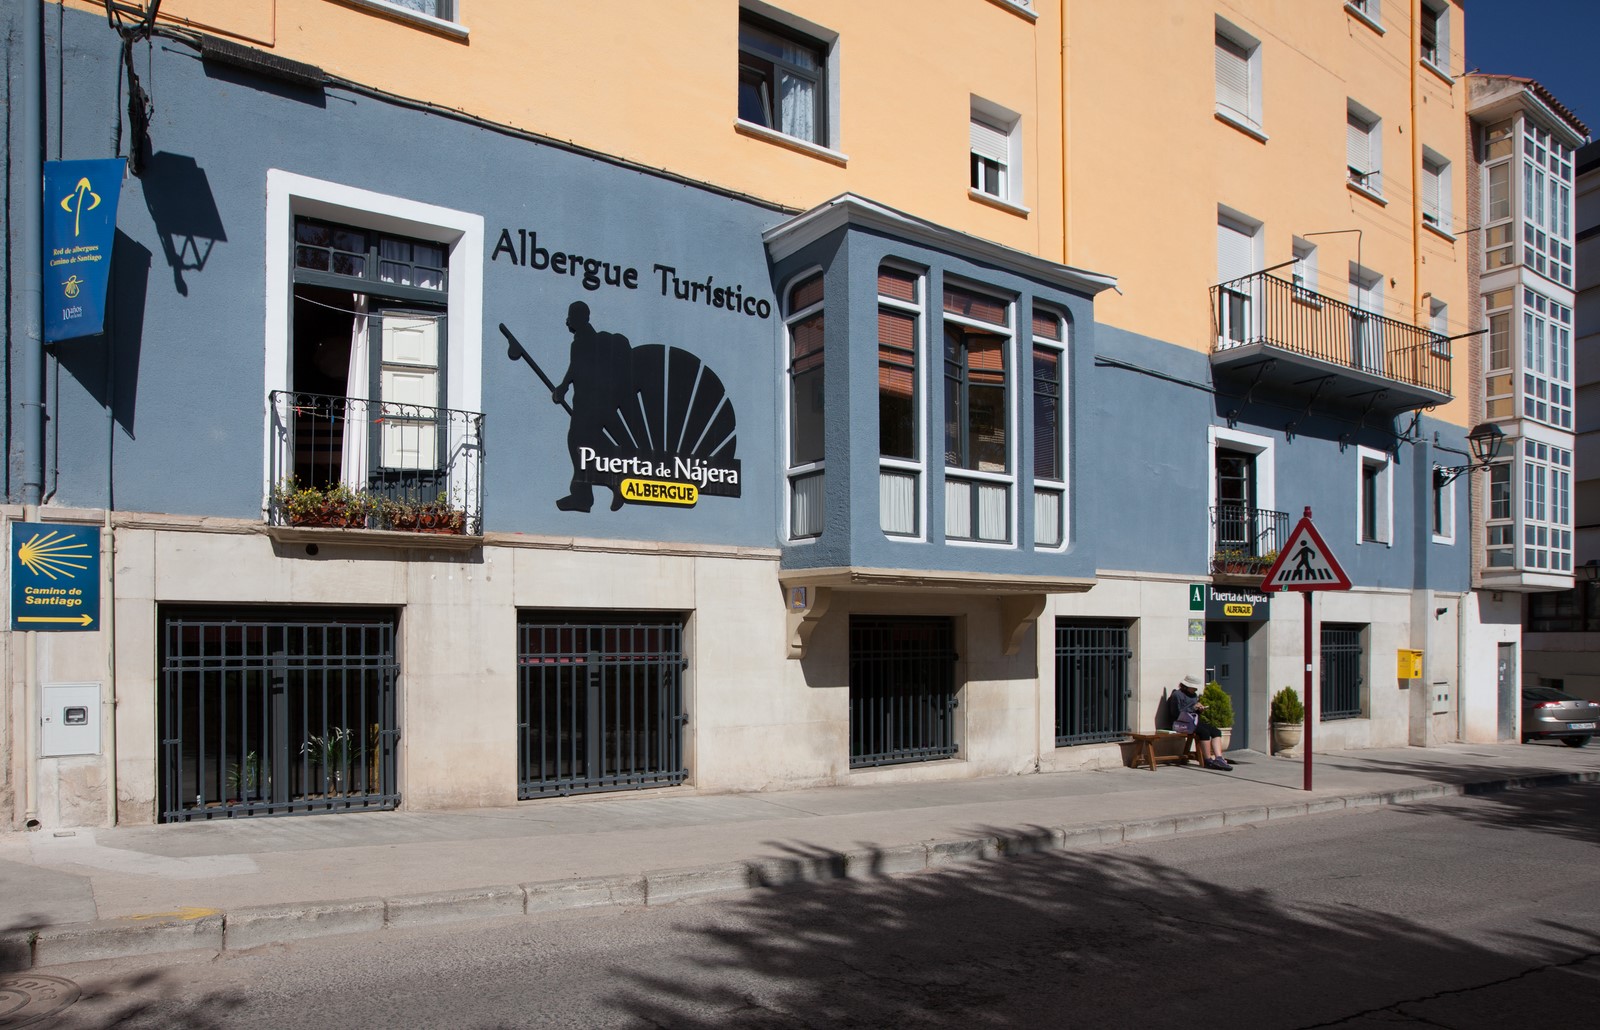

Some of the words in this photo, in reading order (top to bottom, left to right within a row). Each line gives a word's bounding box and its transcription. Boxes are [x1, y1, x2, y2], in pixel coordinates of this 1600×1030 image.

[53, 248, 64, 256] Red
[64, 247, 71, 255] de
[72, 245, 99, 253] albergues
[50, 258, 69, 267] Camino
[70, 256, 77, 264] de
[77, 254, 102, 262] Santiago
[492, 228, 638, 290] Albergue
[653, 263, 771, 319] Turístico
[62, 308, 70, 320] 10
[579, 446, 652, 476] Puerta
[655, 462, 671, 478] de
[674, 457, 738, 488] Nájera
[625, 482, 695, 501] ALBERGUE
[24, 586, 66, 595] Camino
[68, 587, 82, 596] de
[1192, 587, 1201, 601] A
[1210, 587, 1236, 602] Puerta
[1236, 593, 1243, 602] de
[25, 595, 82, 607] Santiago
[1226, 605, 1252, 614] ALBERGUE
